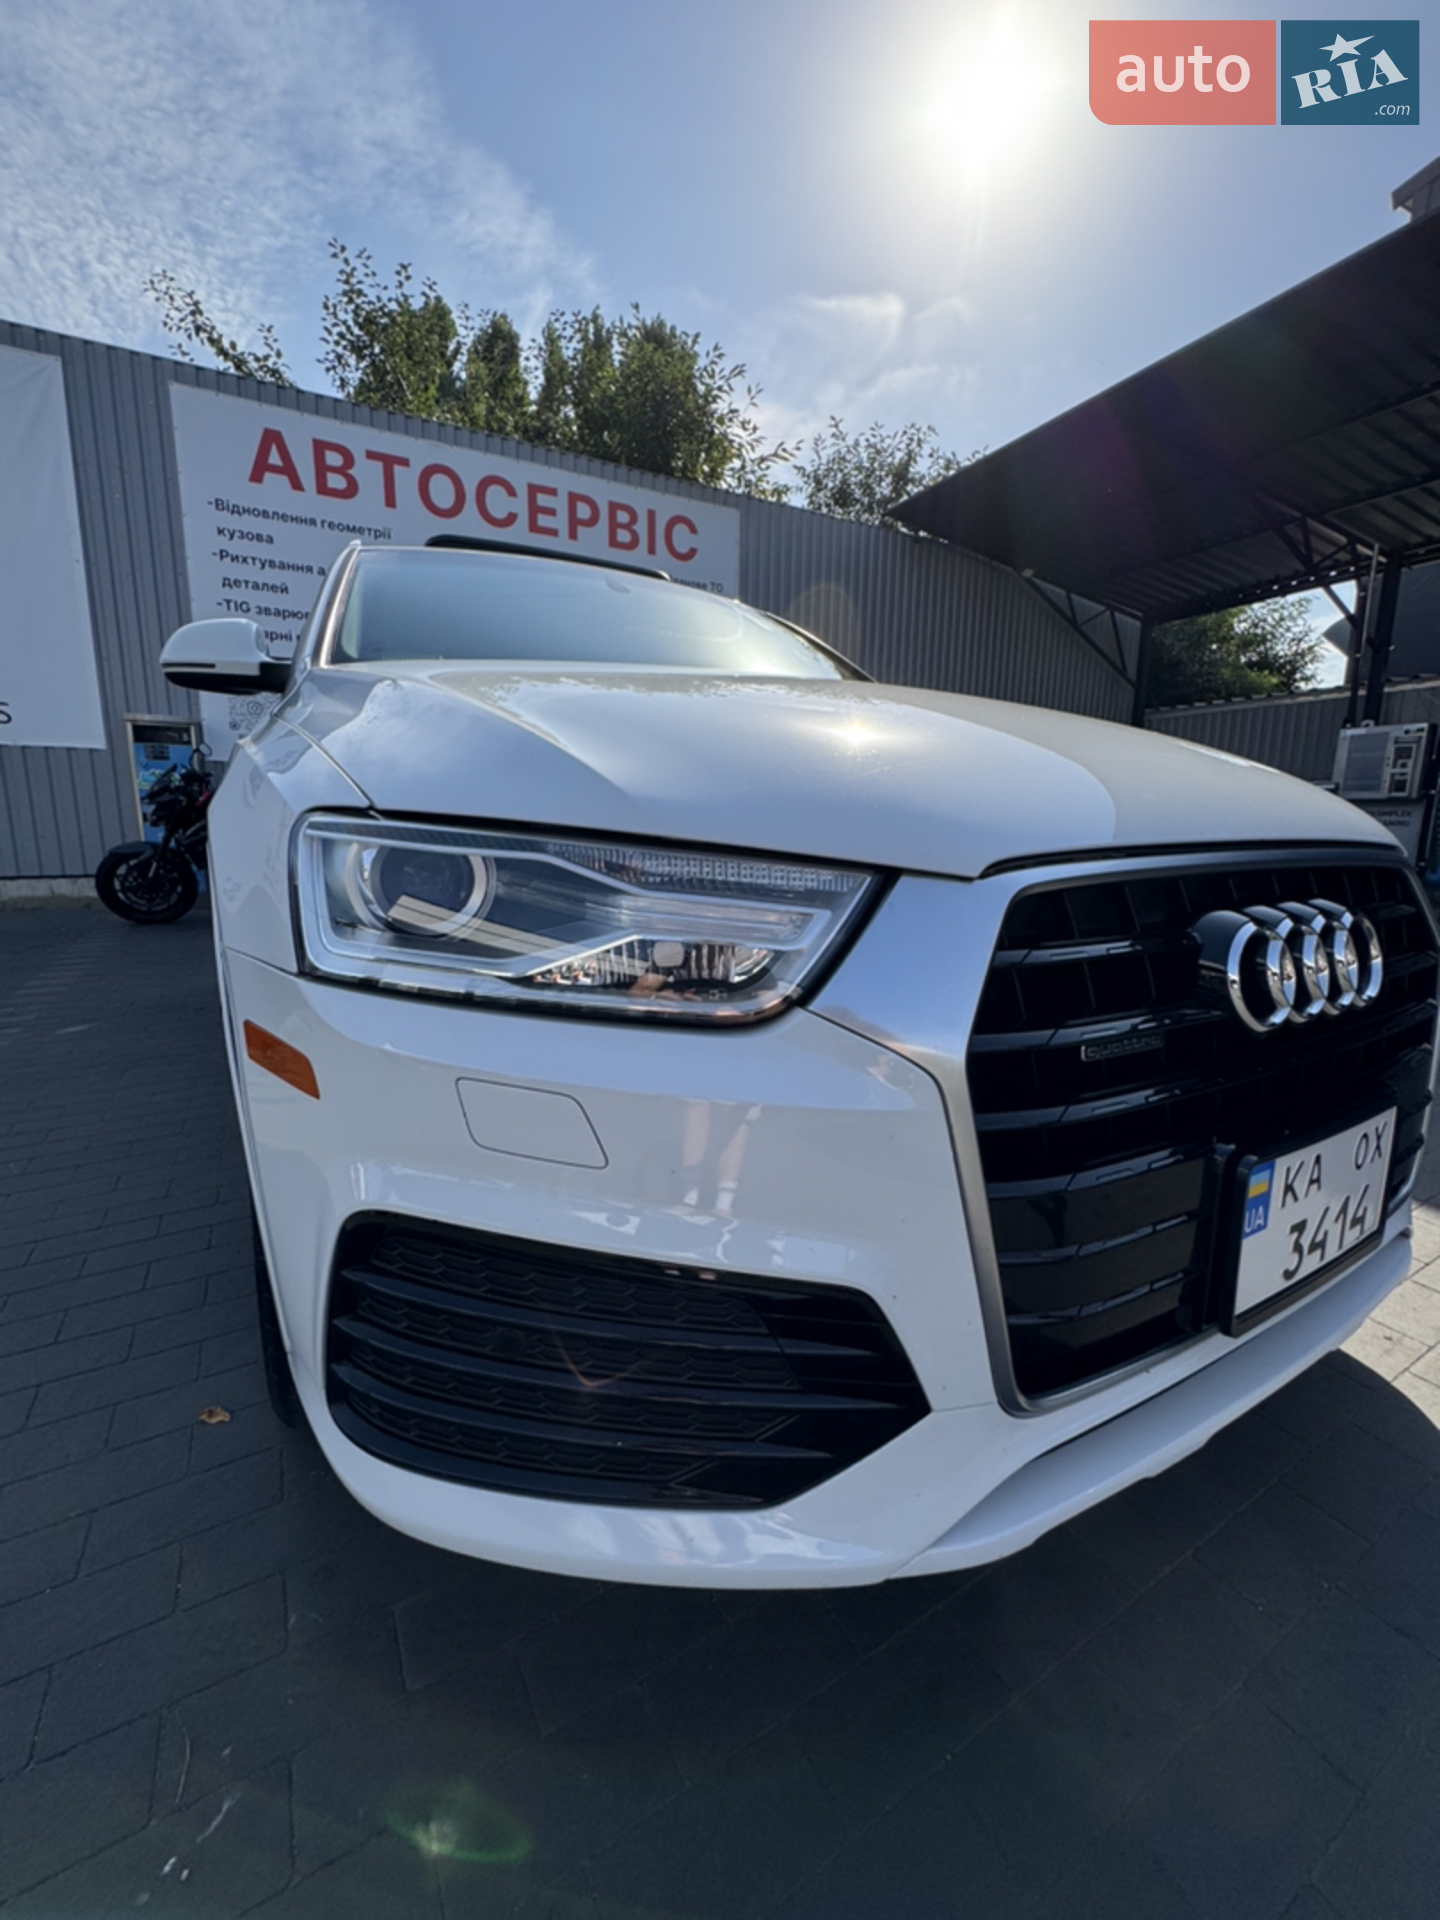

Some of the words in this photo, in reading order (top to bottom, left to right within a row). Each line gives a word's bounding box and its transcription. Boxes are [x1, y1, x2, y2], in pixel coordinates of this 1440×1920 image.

[248, 427, 699, 562] АВТОСЕРВІС
[207, 497, 317, 528] -Відновлення
[320, 518, 393, 541] геометрії
[216, 526, 275, 545] кузова
[211, 550, 314, 575] -Рихтування
[221, 575, 290, 596] деталей
[1278, 1153, 1322, 1209] KA
[1354, 1121, 1388, 1171] OX
[1243, 1206, 1266, 1232] UA
[1281, 1183, 1370, 1281] 3414
